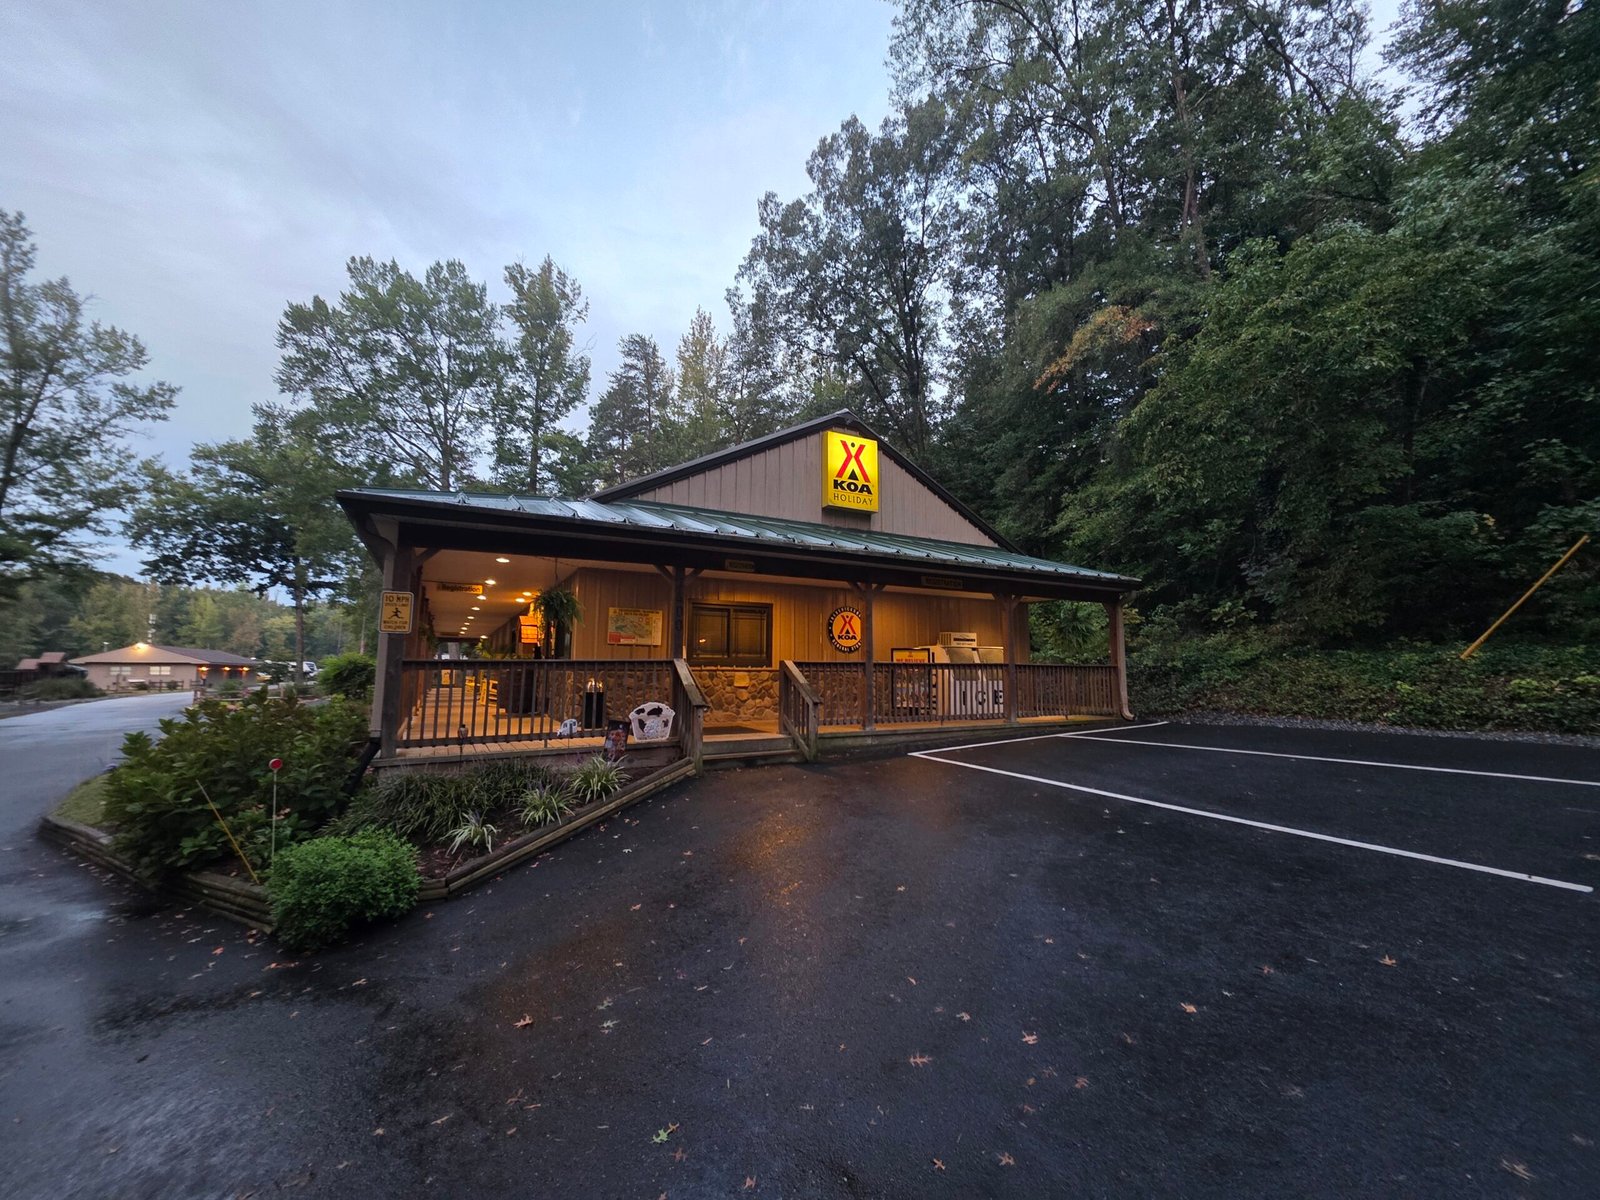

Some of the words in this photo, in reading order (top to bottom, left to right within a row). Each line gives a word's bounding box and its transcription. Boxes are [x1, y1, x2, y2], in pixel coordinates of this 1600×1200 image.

[833, 479, 873, 495] KOA
[833, 493, 873, 506] HOLIDAY
[441, 583, 480, 593] Registration
[396, 595, 409, 603] MPH
